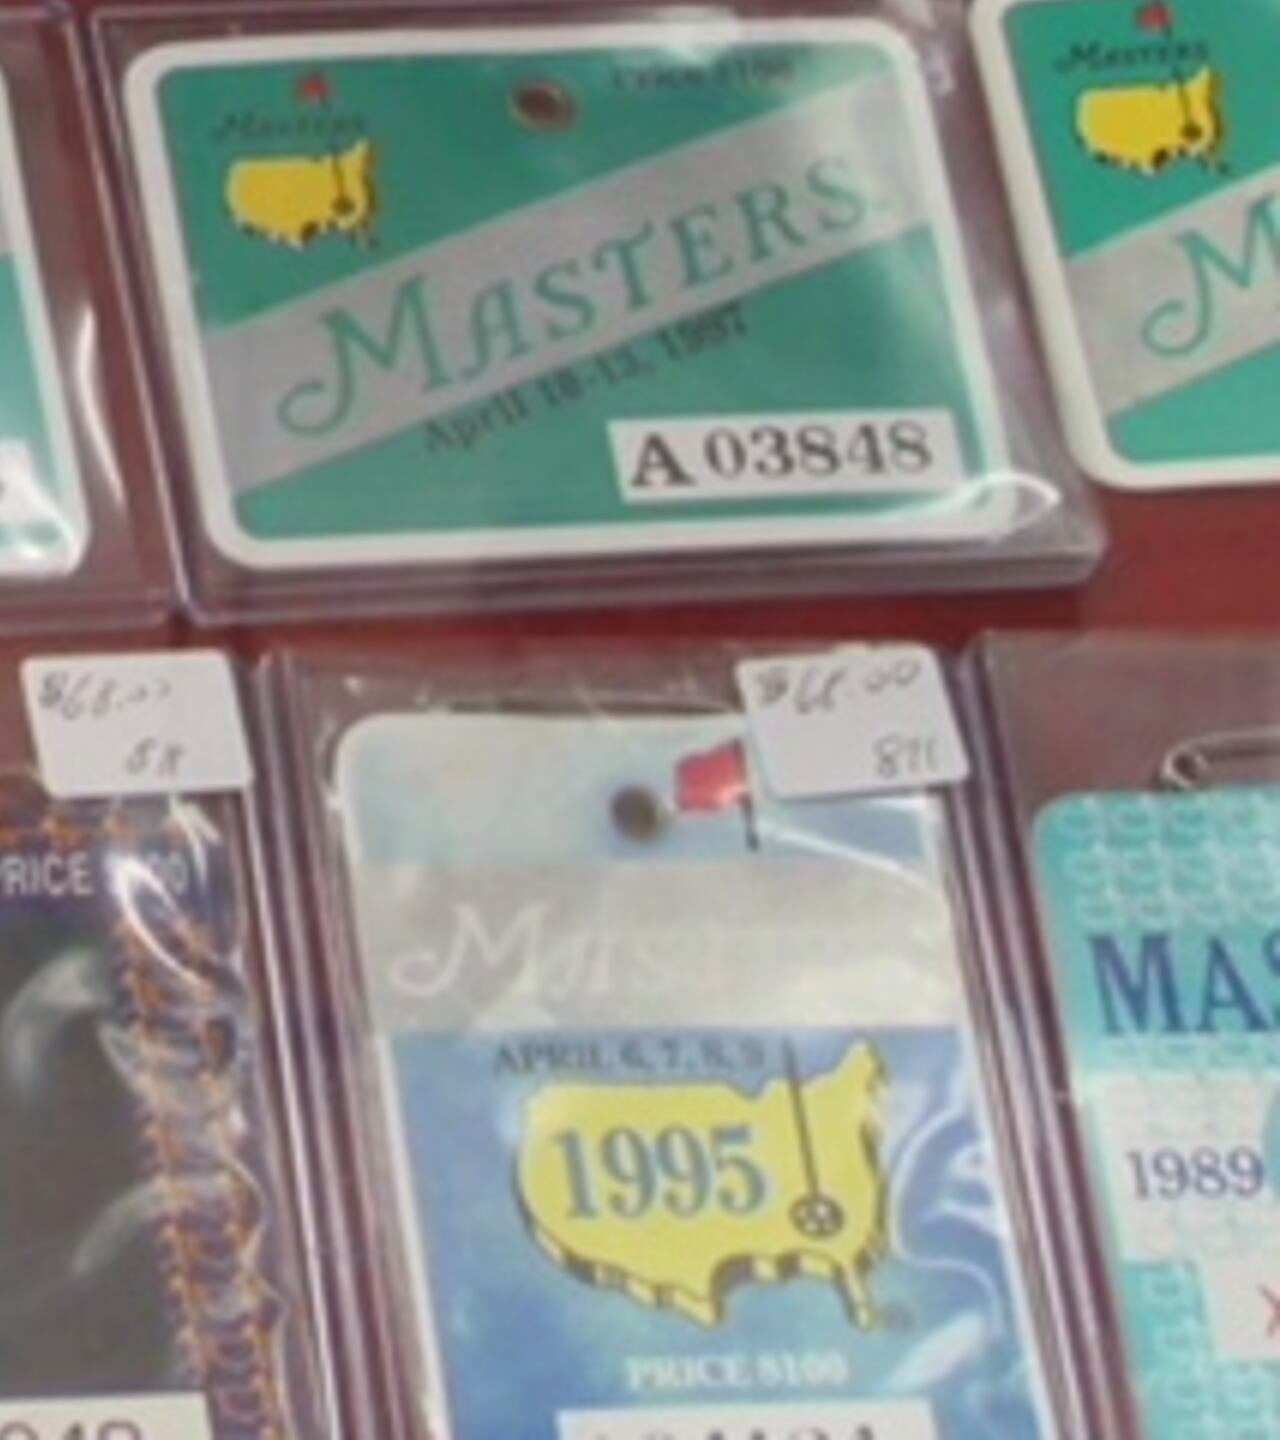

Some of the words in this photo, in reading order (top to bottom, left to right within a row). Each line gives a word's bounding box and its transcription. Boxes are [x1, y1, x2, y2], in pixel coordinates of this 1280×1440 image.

[277, 163, 873, 438] MASTERS
[631, 438, 696, 489] A
[705, 422, 933, 478] 03848
[492, 1039, 606, 1076] APRIL
[553, 1126, 768, 1221] 1995
[1127, 1146, 1264, 1201] 1989
